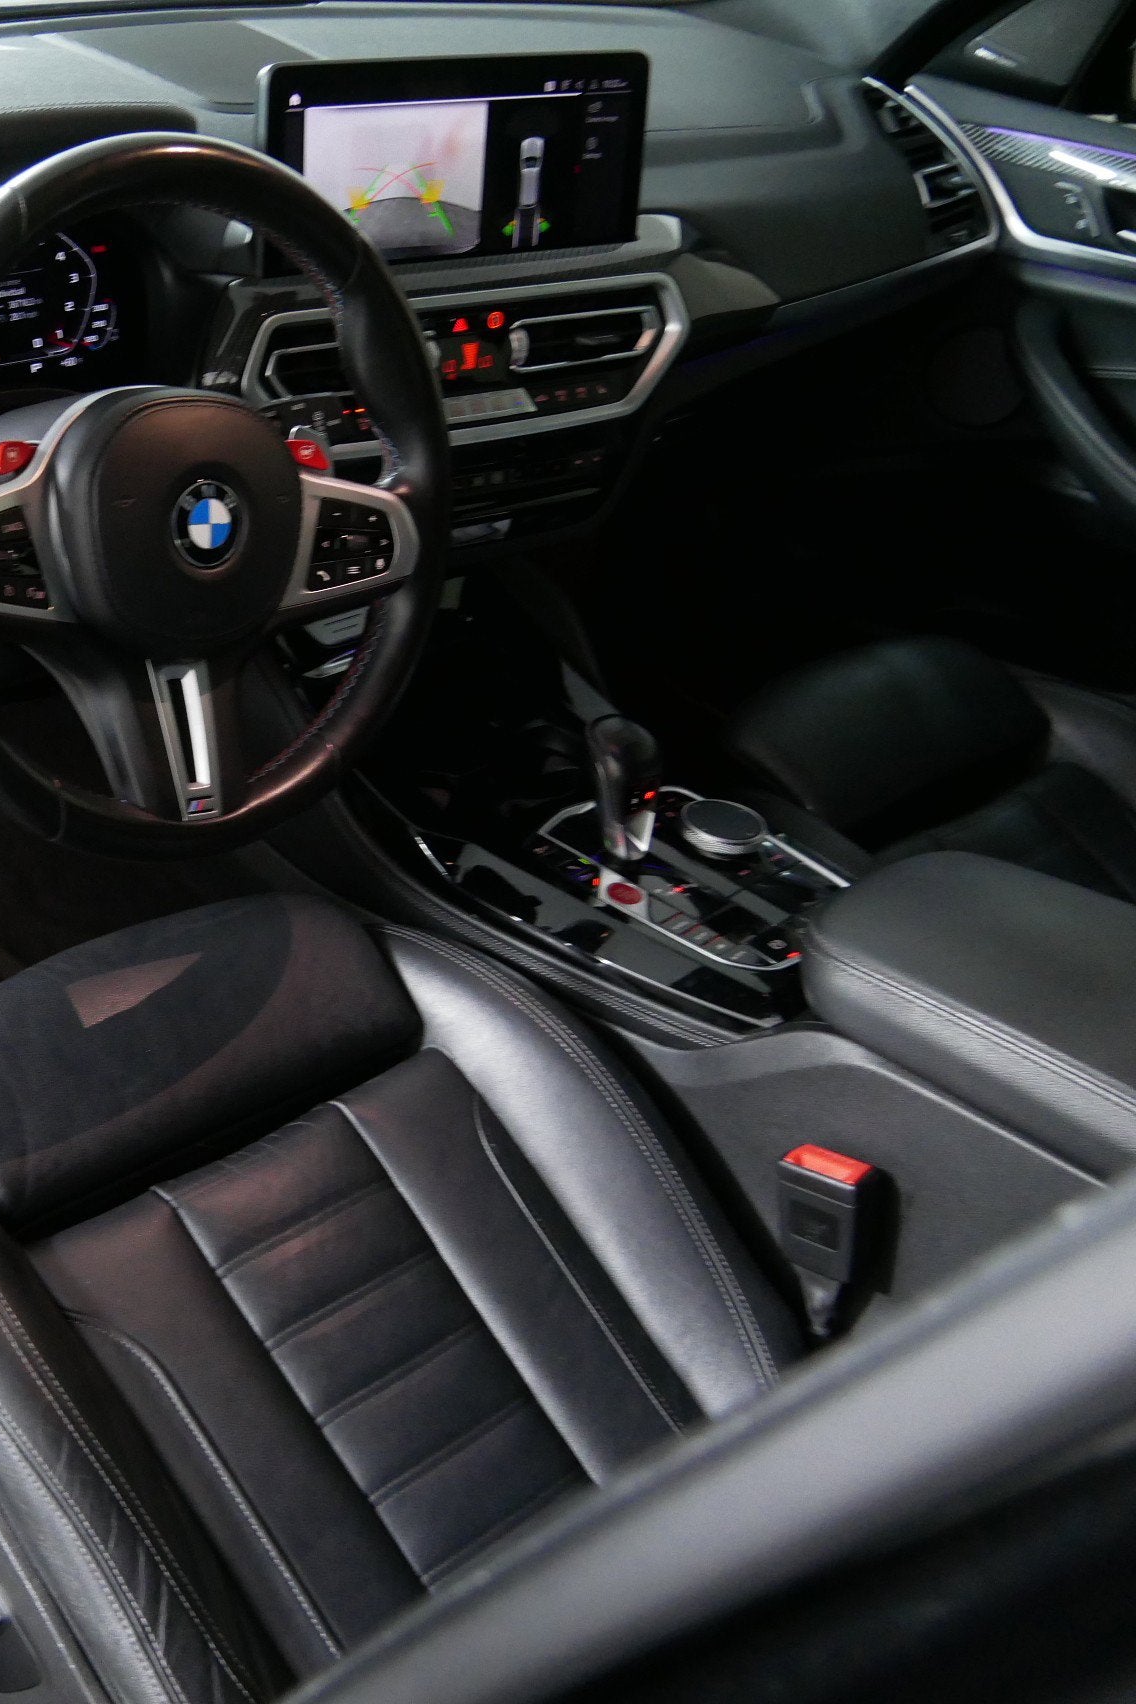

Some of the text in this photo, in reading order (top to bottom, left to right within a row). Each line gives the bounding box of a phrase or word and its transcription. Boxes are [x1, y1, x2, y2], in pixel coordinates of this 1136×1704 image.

[55, 251, 66, 261] 4
[69, 273, 80, 284] 3
[64, 301, 75, 312] 2
